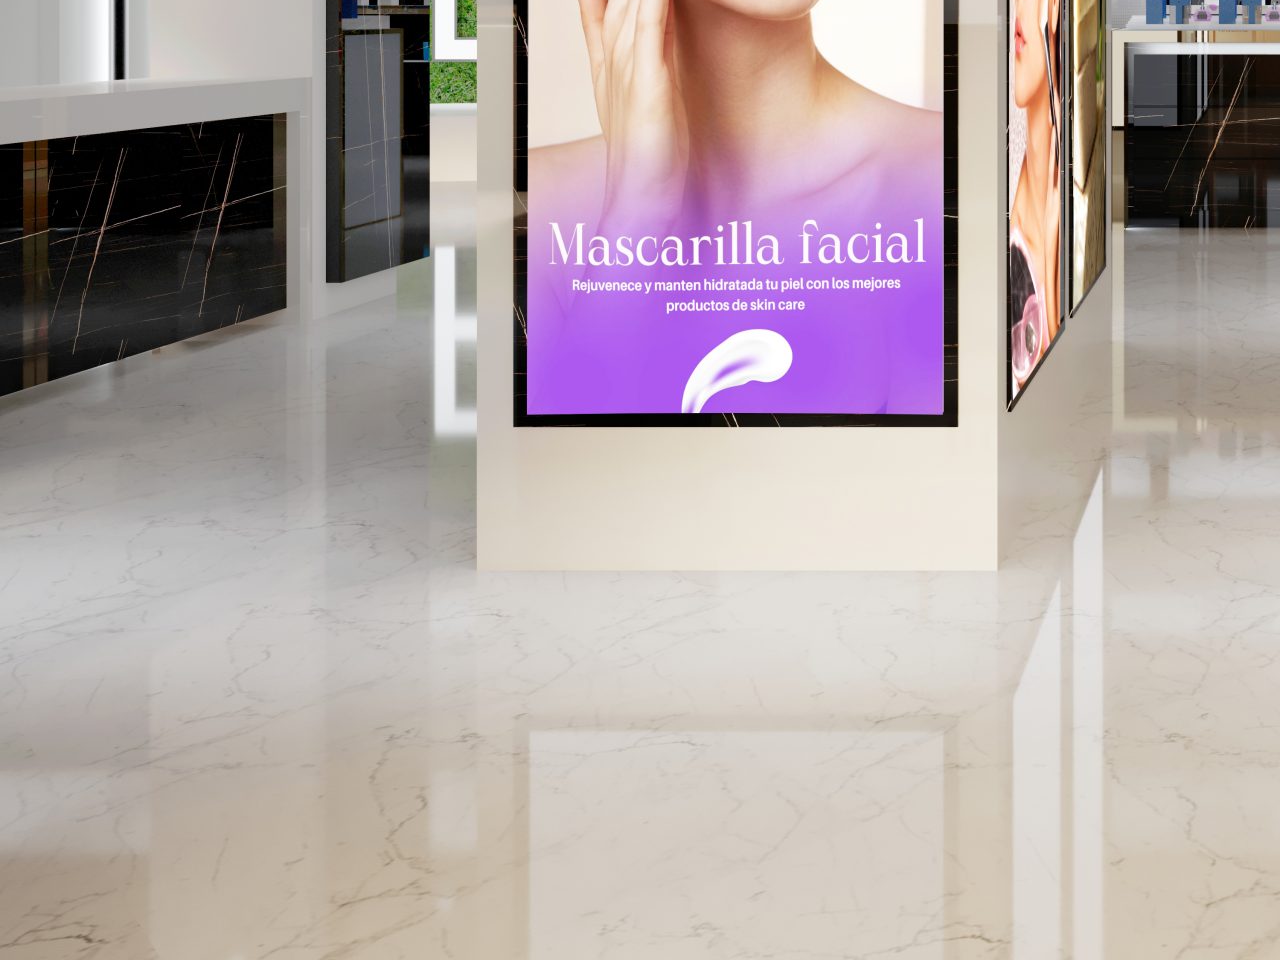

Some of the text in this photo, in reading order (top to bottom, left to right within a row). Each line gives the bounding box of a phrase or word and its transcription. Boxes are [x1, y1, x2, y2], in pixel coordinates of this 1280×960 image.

[549, 218, 928, 266] Mascarilla facial
[572, 277, 901, 293] Rejuvenece y manten hidratada tu piel con los mejores
[666, 298, 805, 314] productos de skin care
